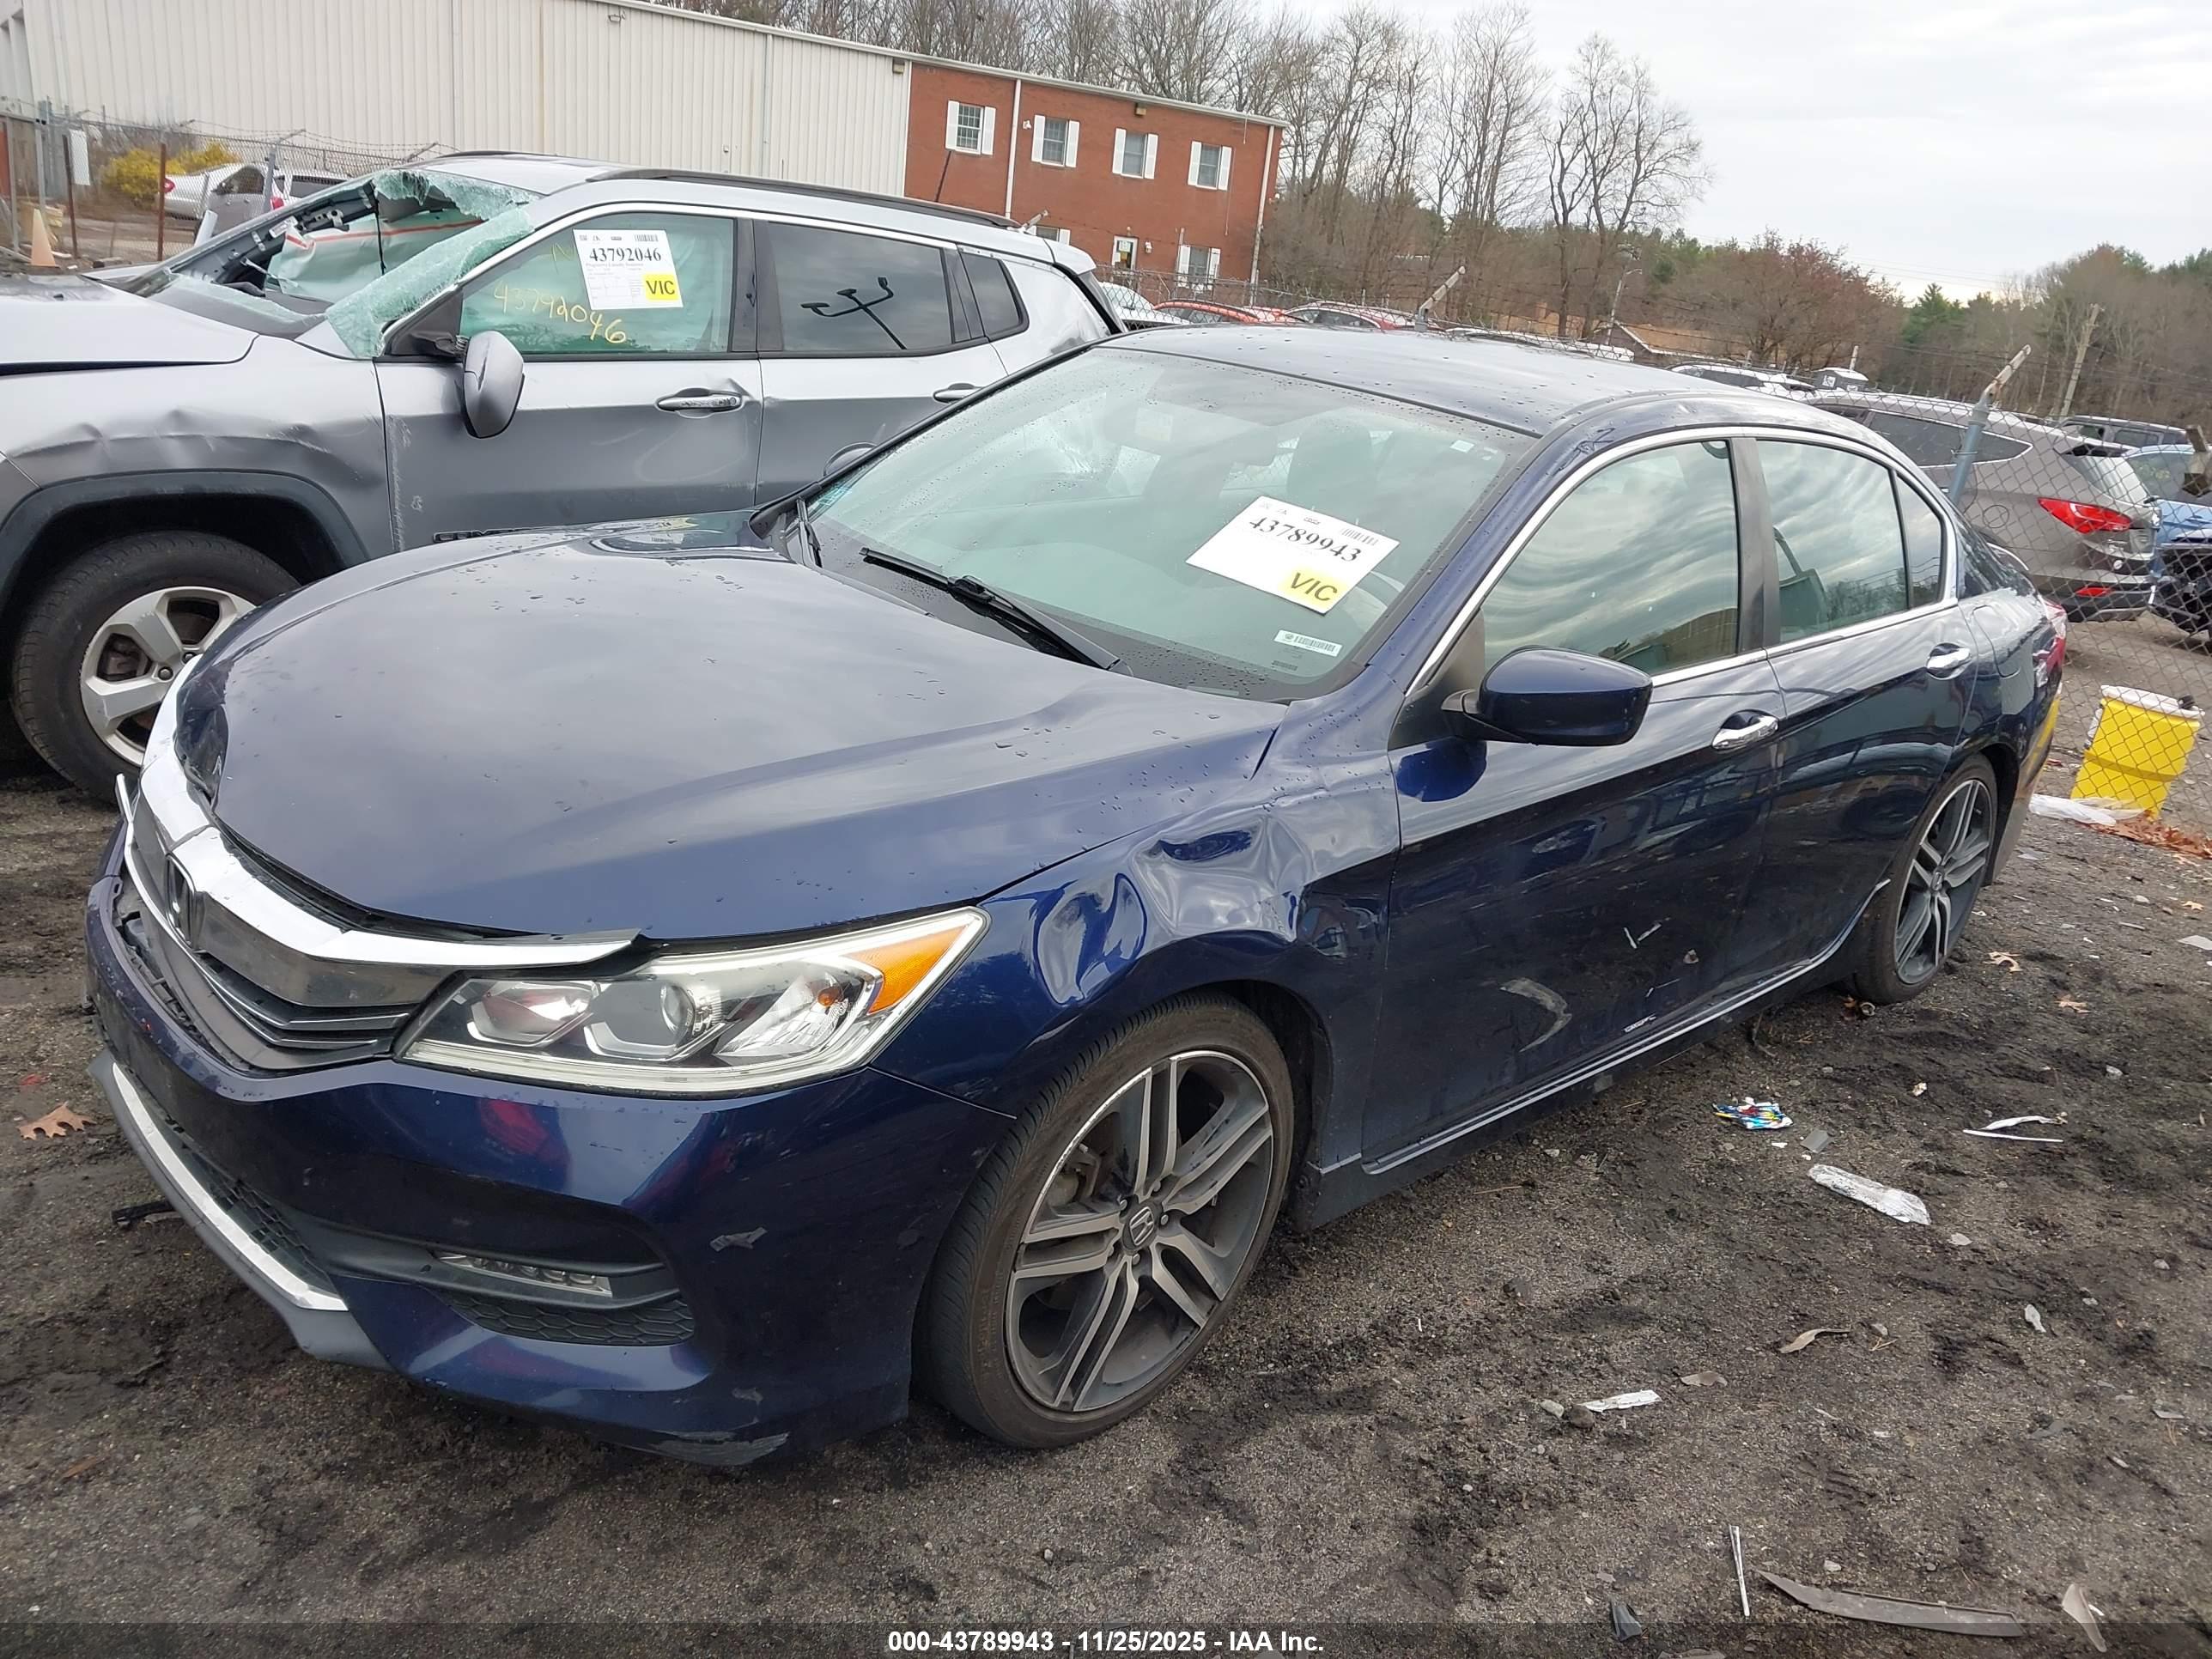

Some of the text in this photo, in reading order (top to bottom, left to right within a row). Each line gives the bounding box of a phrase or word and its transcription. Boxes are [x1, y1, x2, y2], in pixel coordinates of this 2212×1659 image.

[589, 247, 661, 262] 43792046
[645, 280, 675, 295] VIC
[1249, 517, 1361, 562] 43789943
[1291, 572, 1338, 601] VIC
